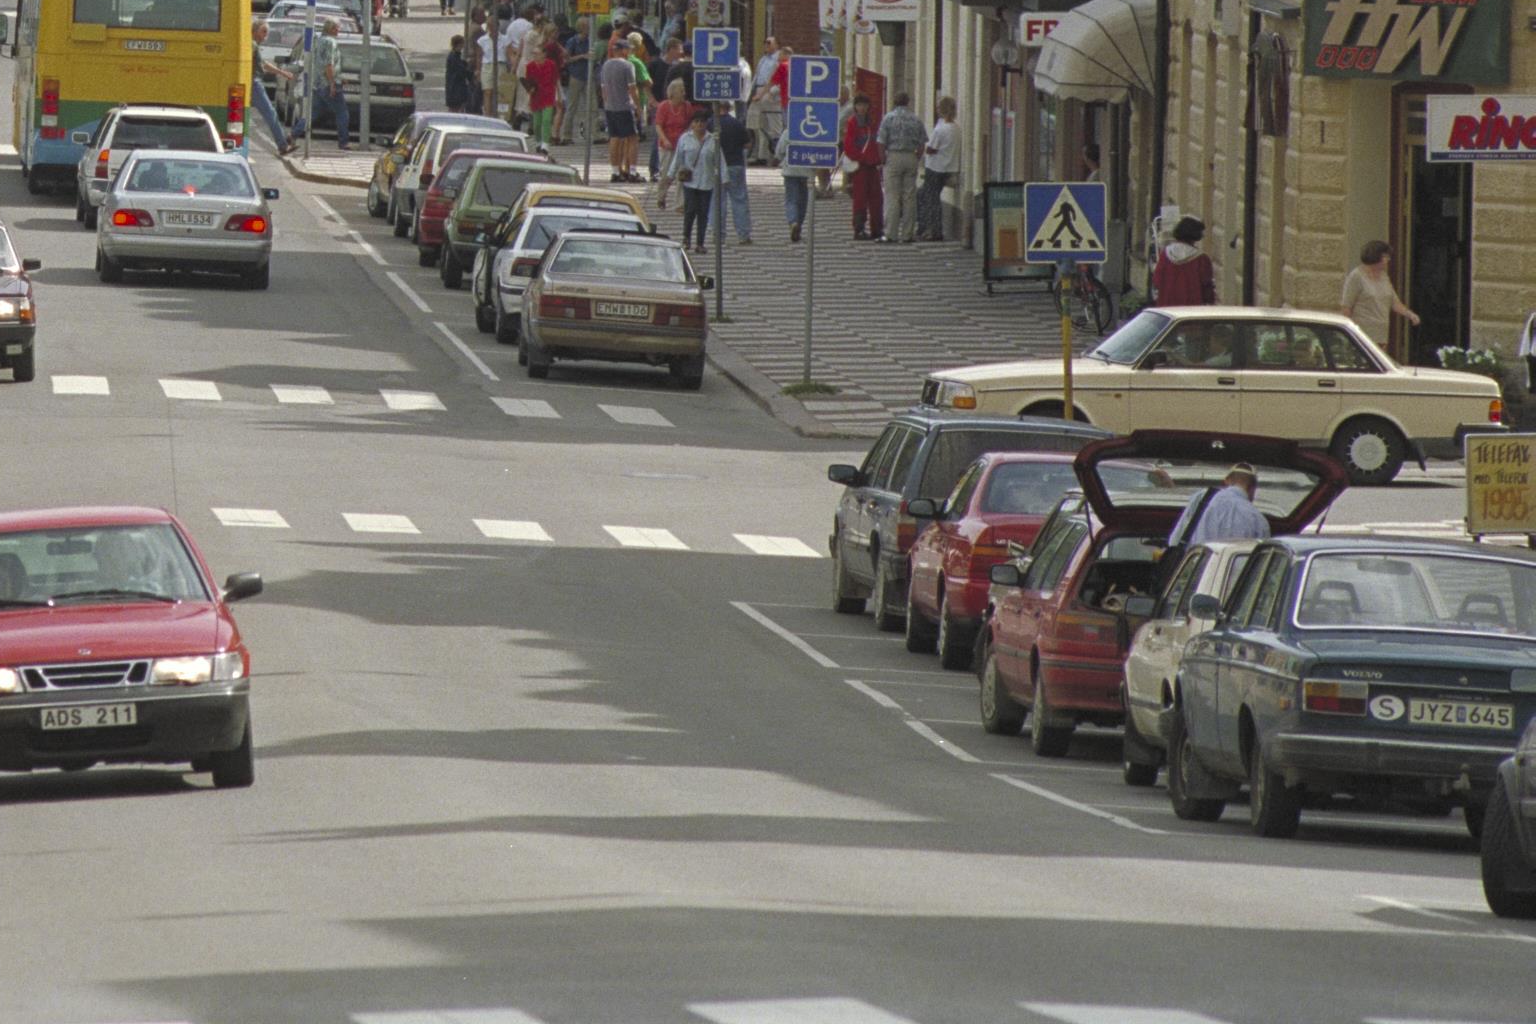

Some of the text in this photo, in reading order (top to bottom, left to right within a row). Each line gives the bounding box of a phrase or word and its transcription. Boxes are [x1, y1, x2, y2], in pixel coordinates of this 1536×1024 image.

[707, 32, 729, 64] P
[805, 60, 830, 95] P
[792, 150, 834, 162] 2 platser
[1472, 441, 1531, 466] TELEFAX
[1342, 669, 1384, 680] VOLVO
[44, 705, 133, 728] ADS 211
[1378, 697, 1511, 727] S JYZ 645
